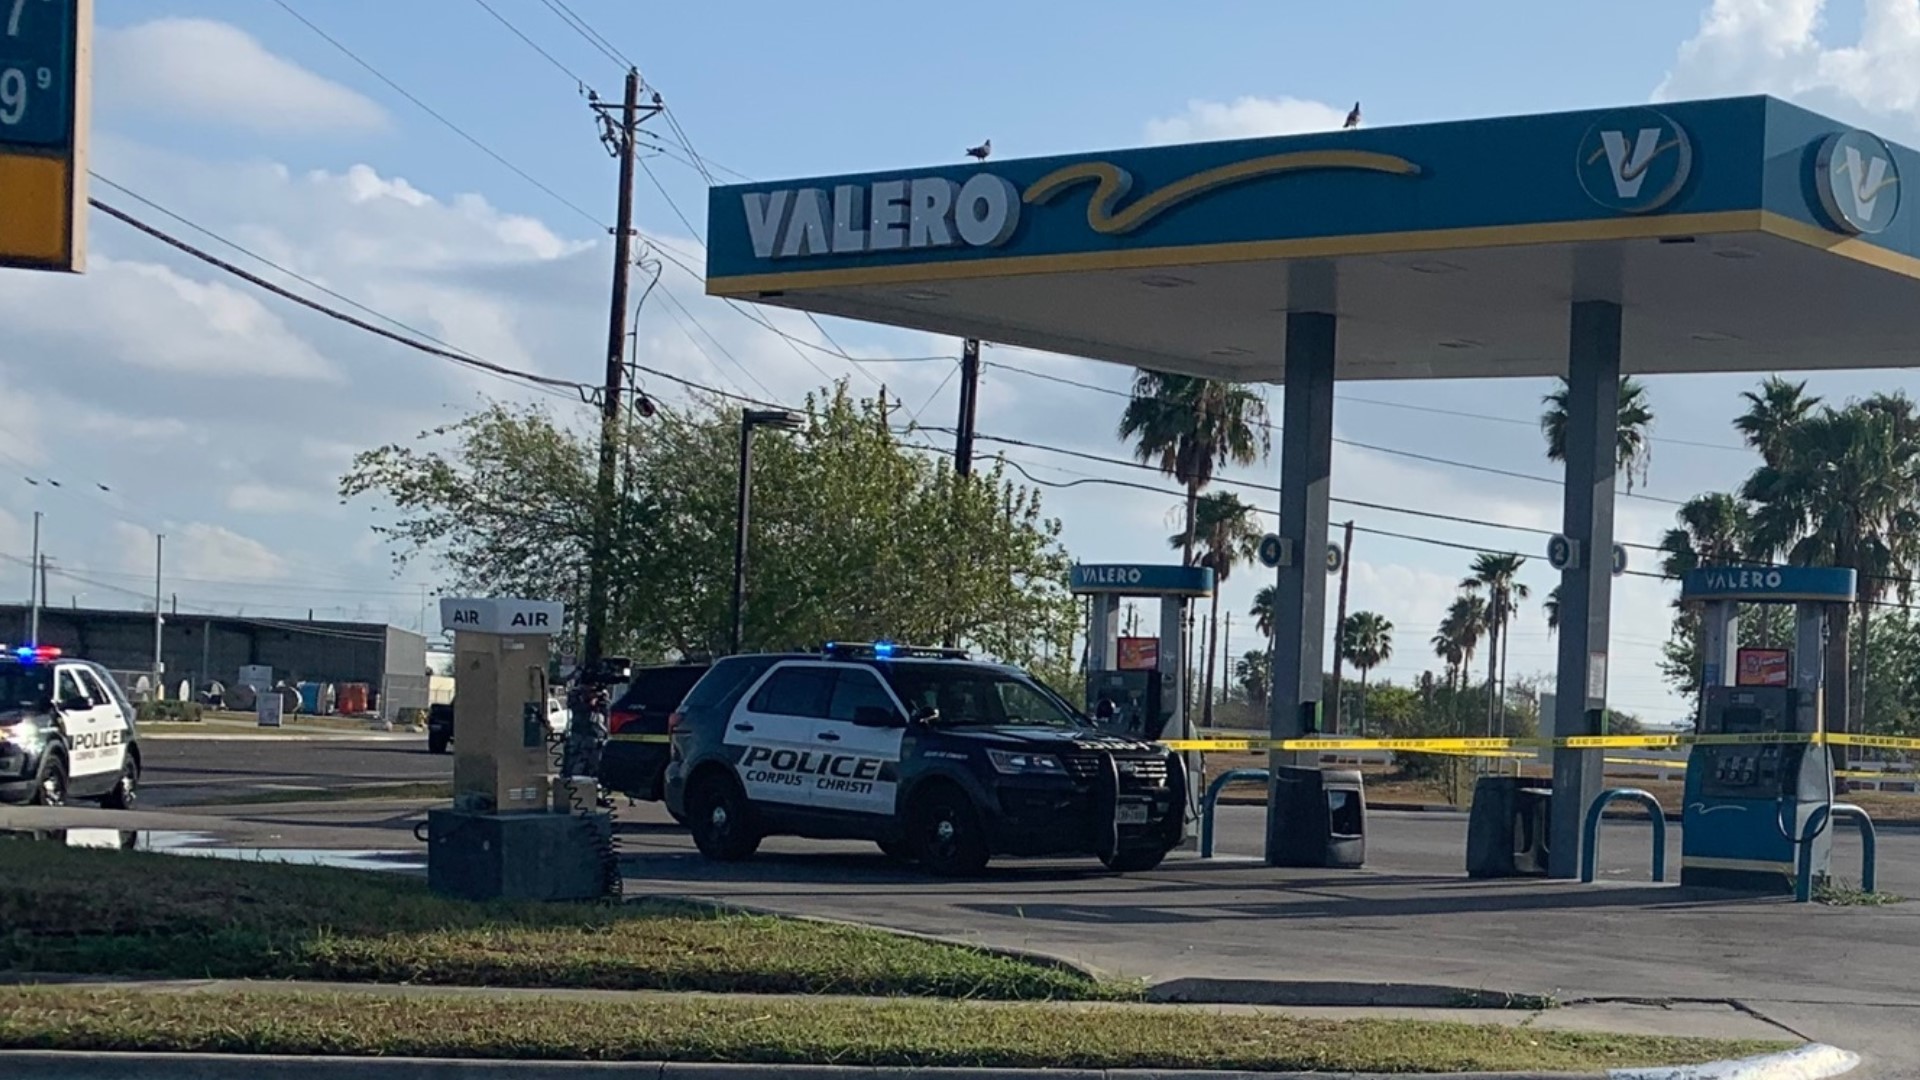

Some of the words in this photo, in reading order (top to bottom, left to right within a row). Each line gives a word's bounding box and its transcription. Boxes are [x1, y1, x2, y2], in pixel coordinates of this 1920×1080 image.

[1600, 127, 1662, 198] V
[1845, 145, 1888, 221] V
[742, 172, 1020, 258] VALERO
[1555, 543, 1565, 560] 2
[1081, 567, 1142, 583] VALERO
[1705, 571, 1782, 588] VALERO
[453, 609, 480, 625] AIR
[511, 612, 549, 626] AIR
[75, 729, 118, 750] POLICE
[742, 745, 881, 781] POLICE
[746, 770, 803, 787] CORPUS
[816, 777, 874, 794] CHRISTI
